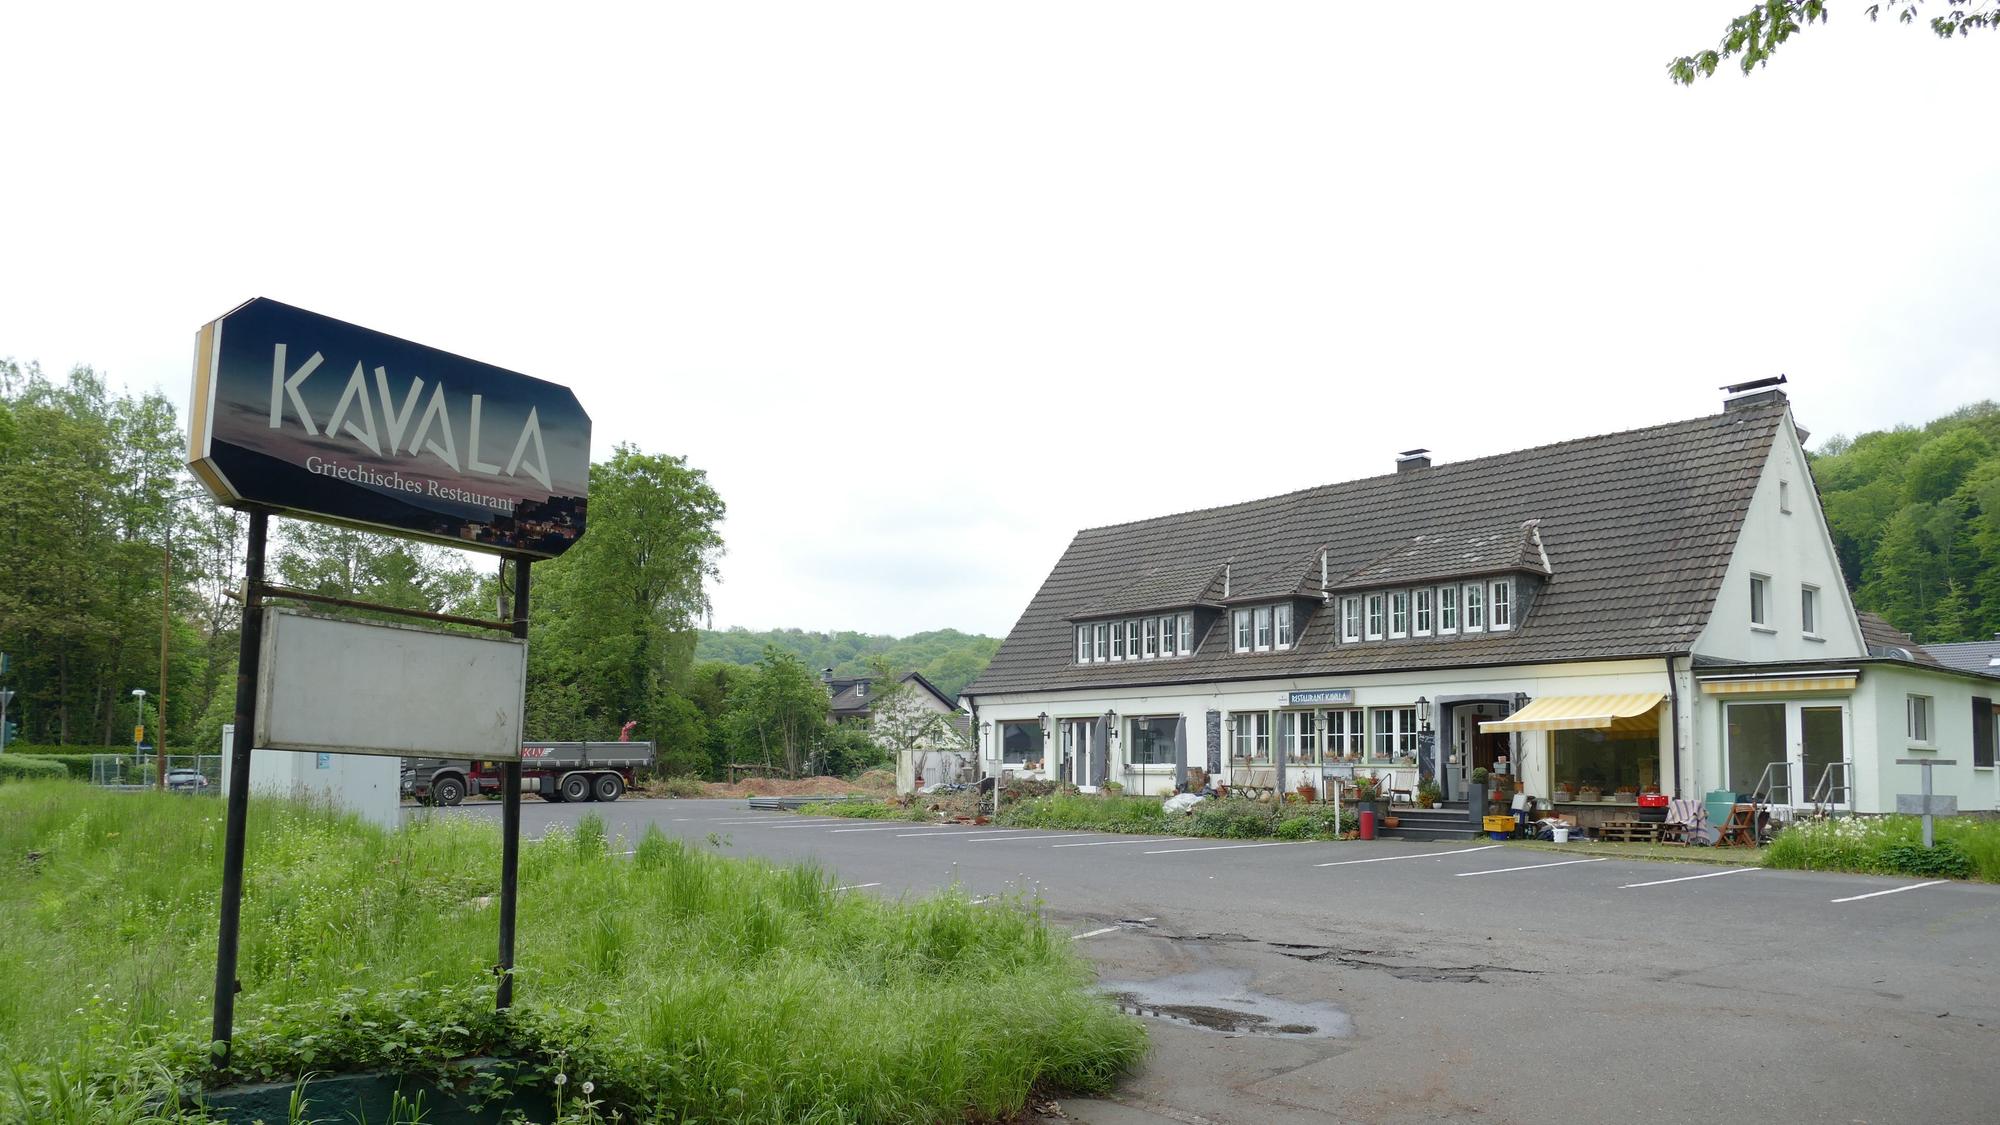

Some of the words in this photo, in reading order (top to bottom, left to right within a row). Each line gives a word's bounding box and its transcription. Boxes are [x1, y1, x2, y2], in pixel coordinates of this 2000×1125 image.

[269, 343, 553, 492] KAVALA
[306, 456, 423, 494] Griechisches
[427, 481, 515, 512] Restaurant
[1291, 693, 1324, 703] RESTAURANT
